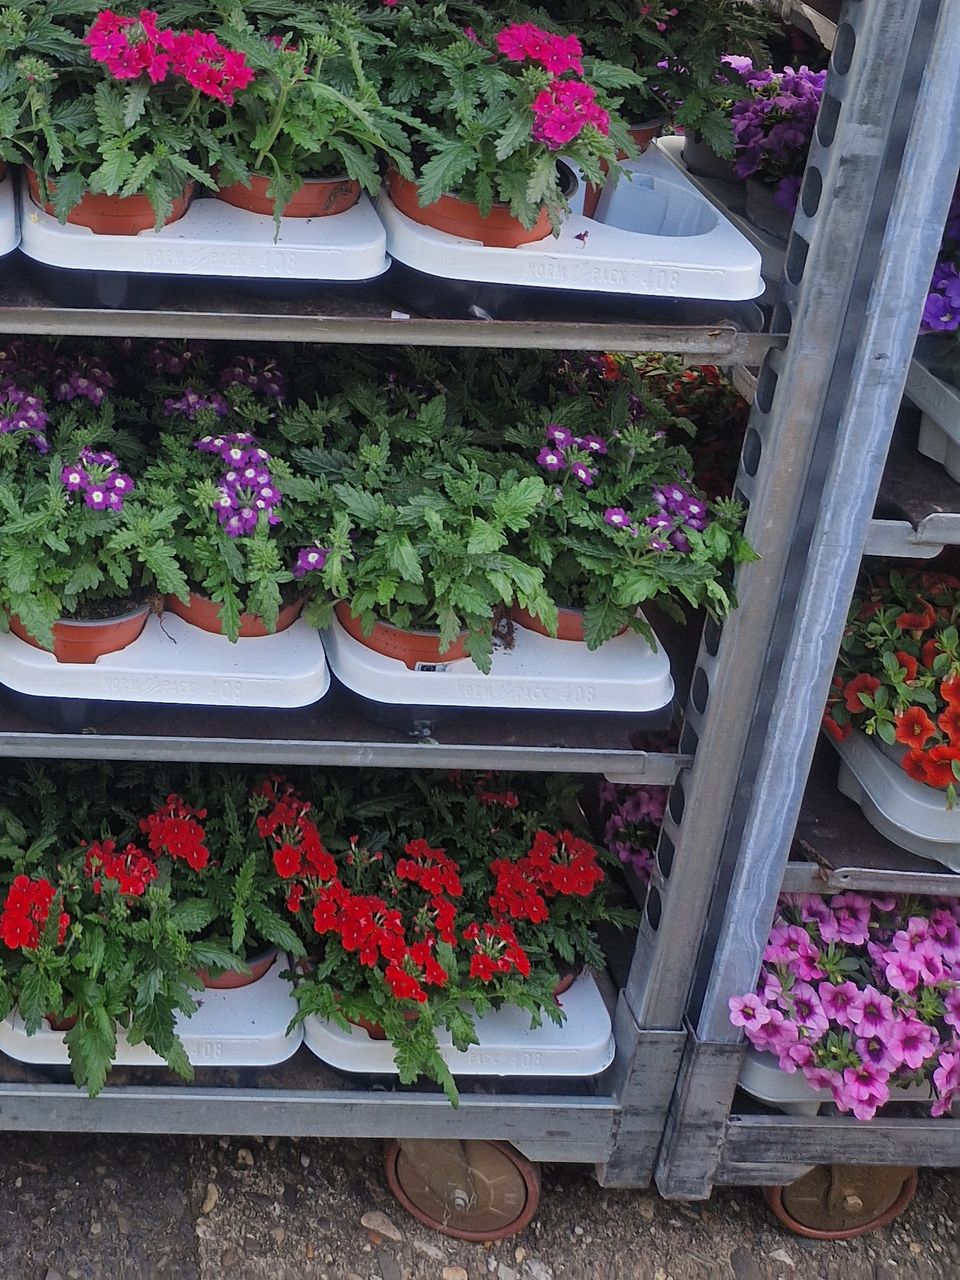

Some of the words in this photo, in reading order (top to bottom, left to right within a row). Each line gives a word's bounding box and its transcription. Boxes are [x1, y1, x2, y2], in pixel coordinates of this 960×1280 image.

[258, 252, 297, 274] 408
[640, 265, 681, 291] 408
[207, 680, 242, 700] 408
[560, 686, 597, 705] 408
